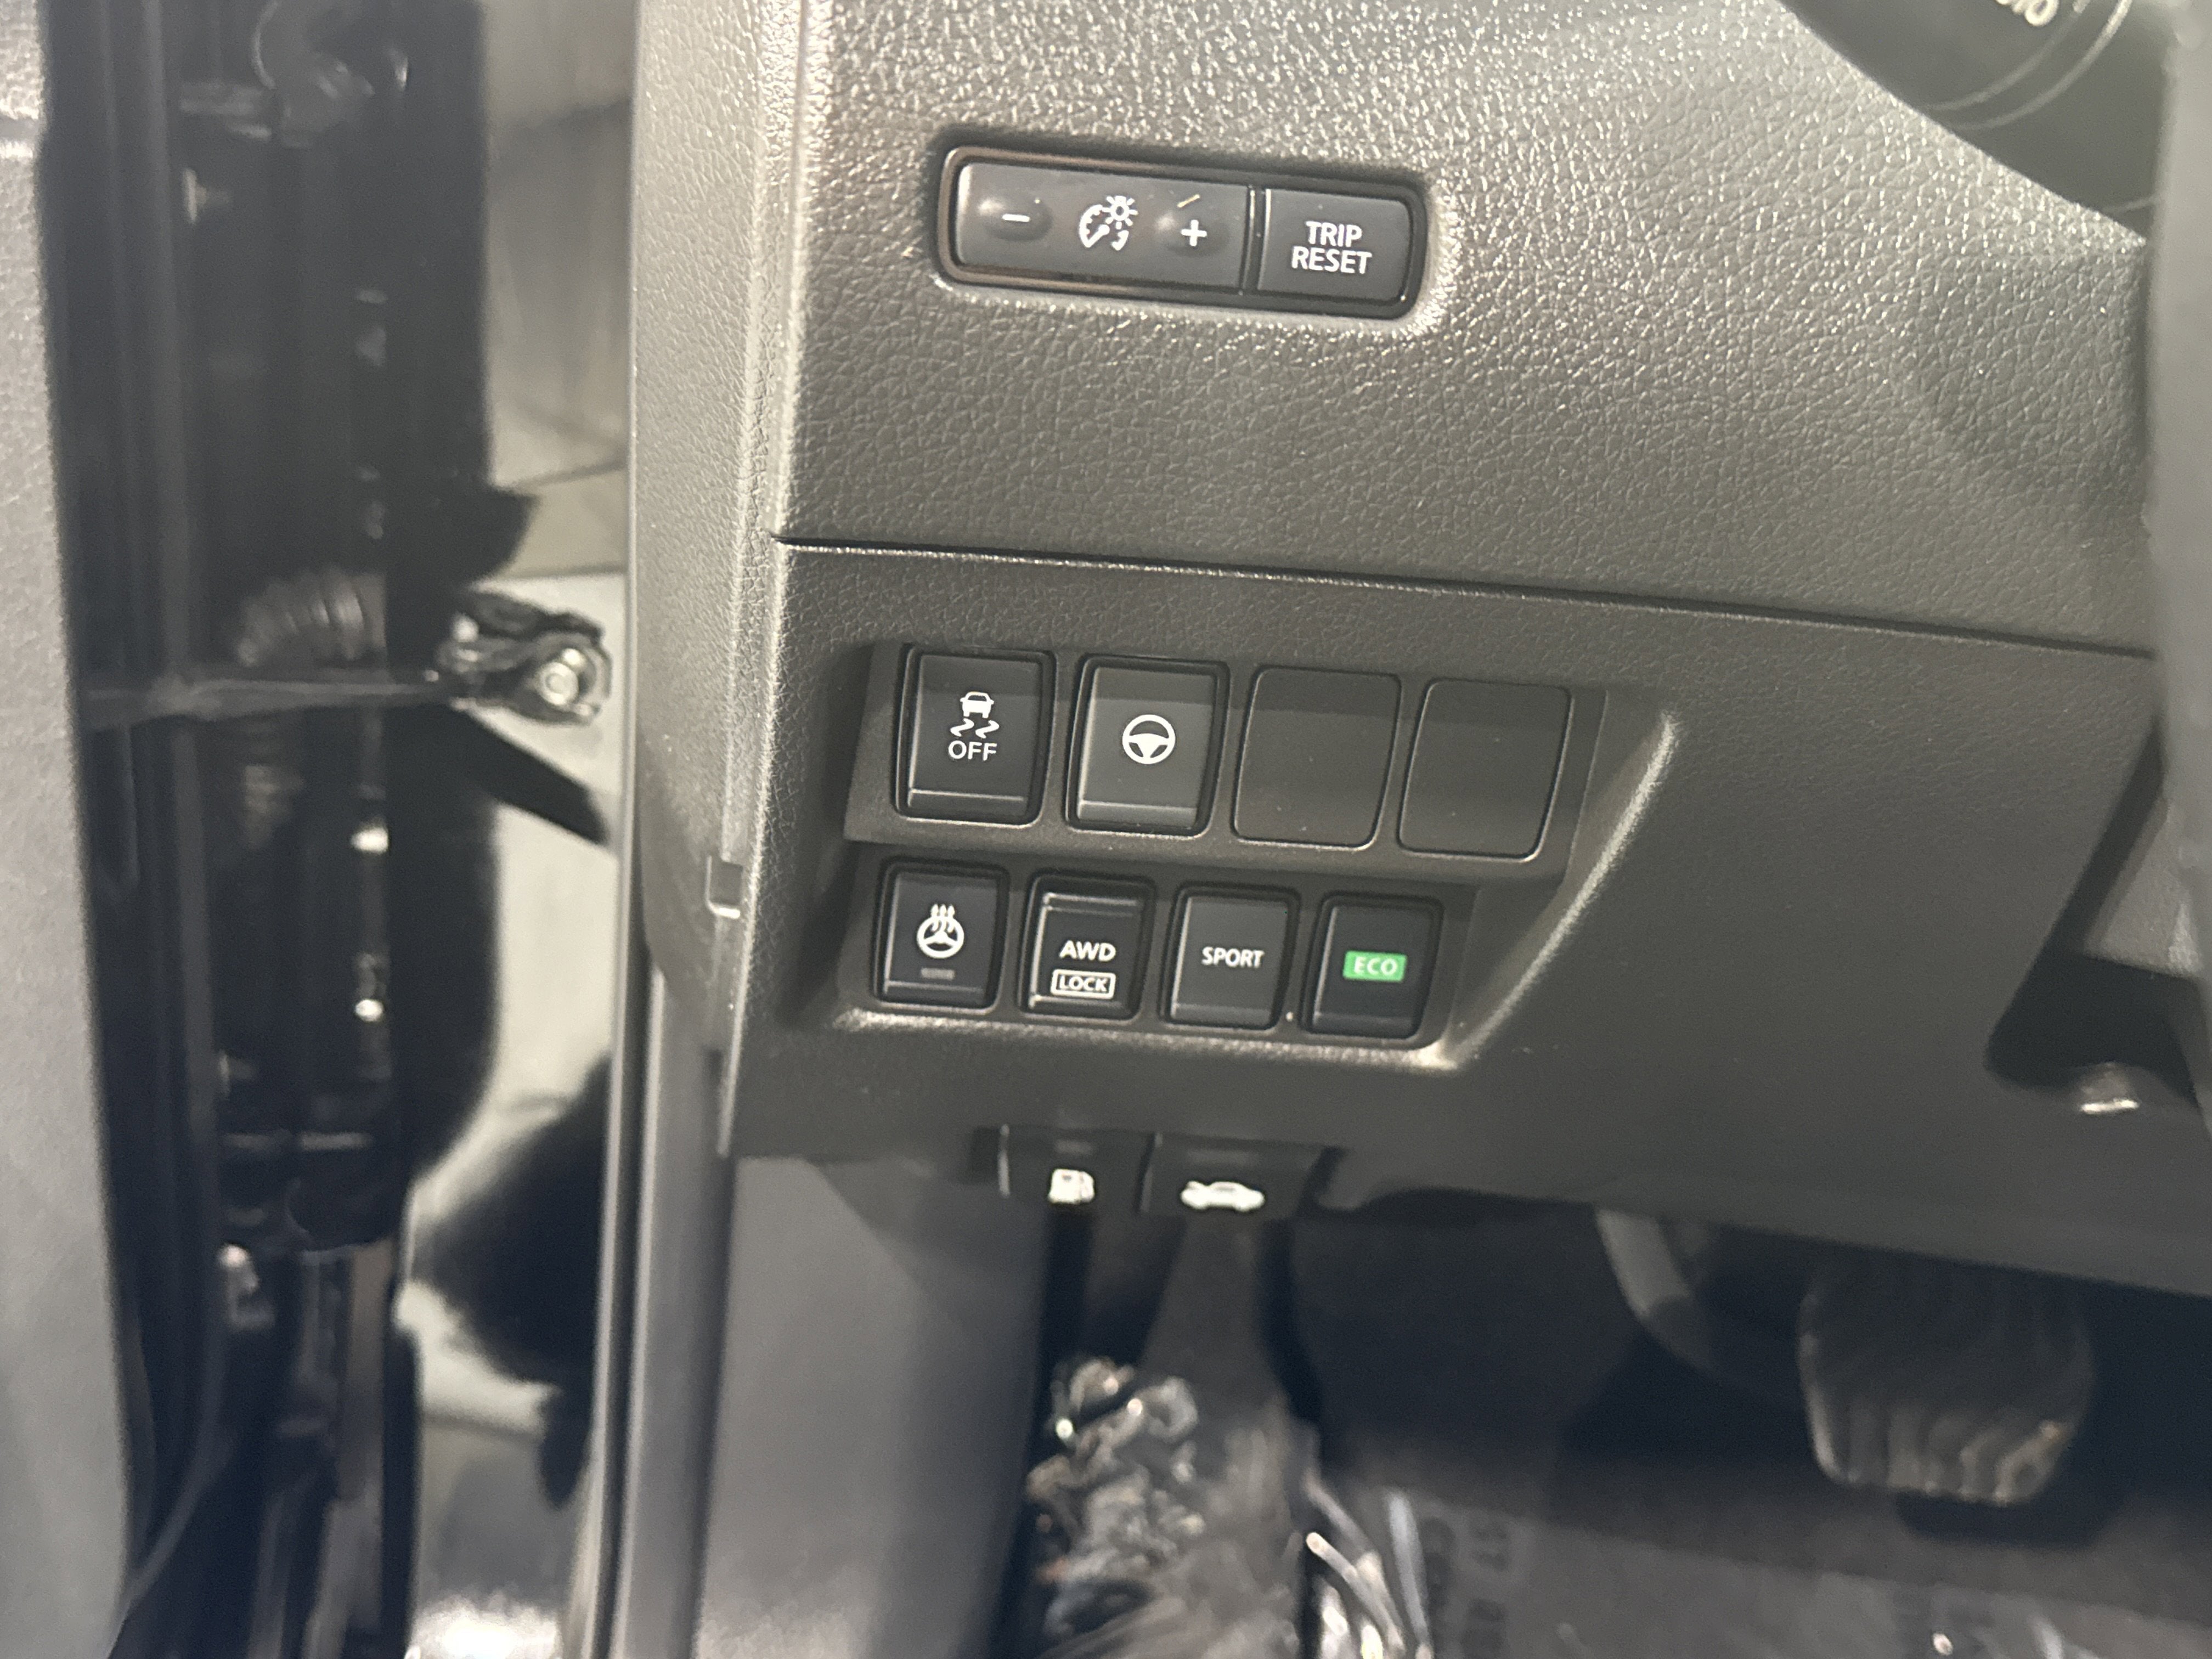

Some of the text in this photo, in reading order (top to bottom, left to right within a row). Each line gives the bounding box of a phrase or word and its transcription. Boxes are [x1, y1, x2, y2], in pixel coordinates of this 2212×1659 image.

[1305, 221, 1363, 247] TRIP
[1291, 246, 1373, 274] RESET
[947, 740, 998, 761] OFF
[1059, 940, 1116, 962] AWD
[1201, 946, 1265, 968] SPORT
[1353, 956, 1398, 976] ECO
[1059, 975, 1108, 992] LOCK
